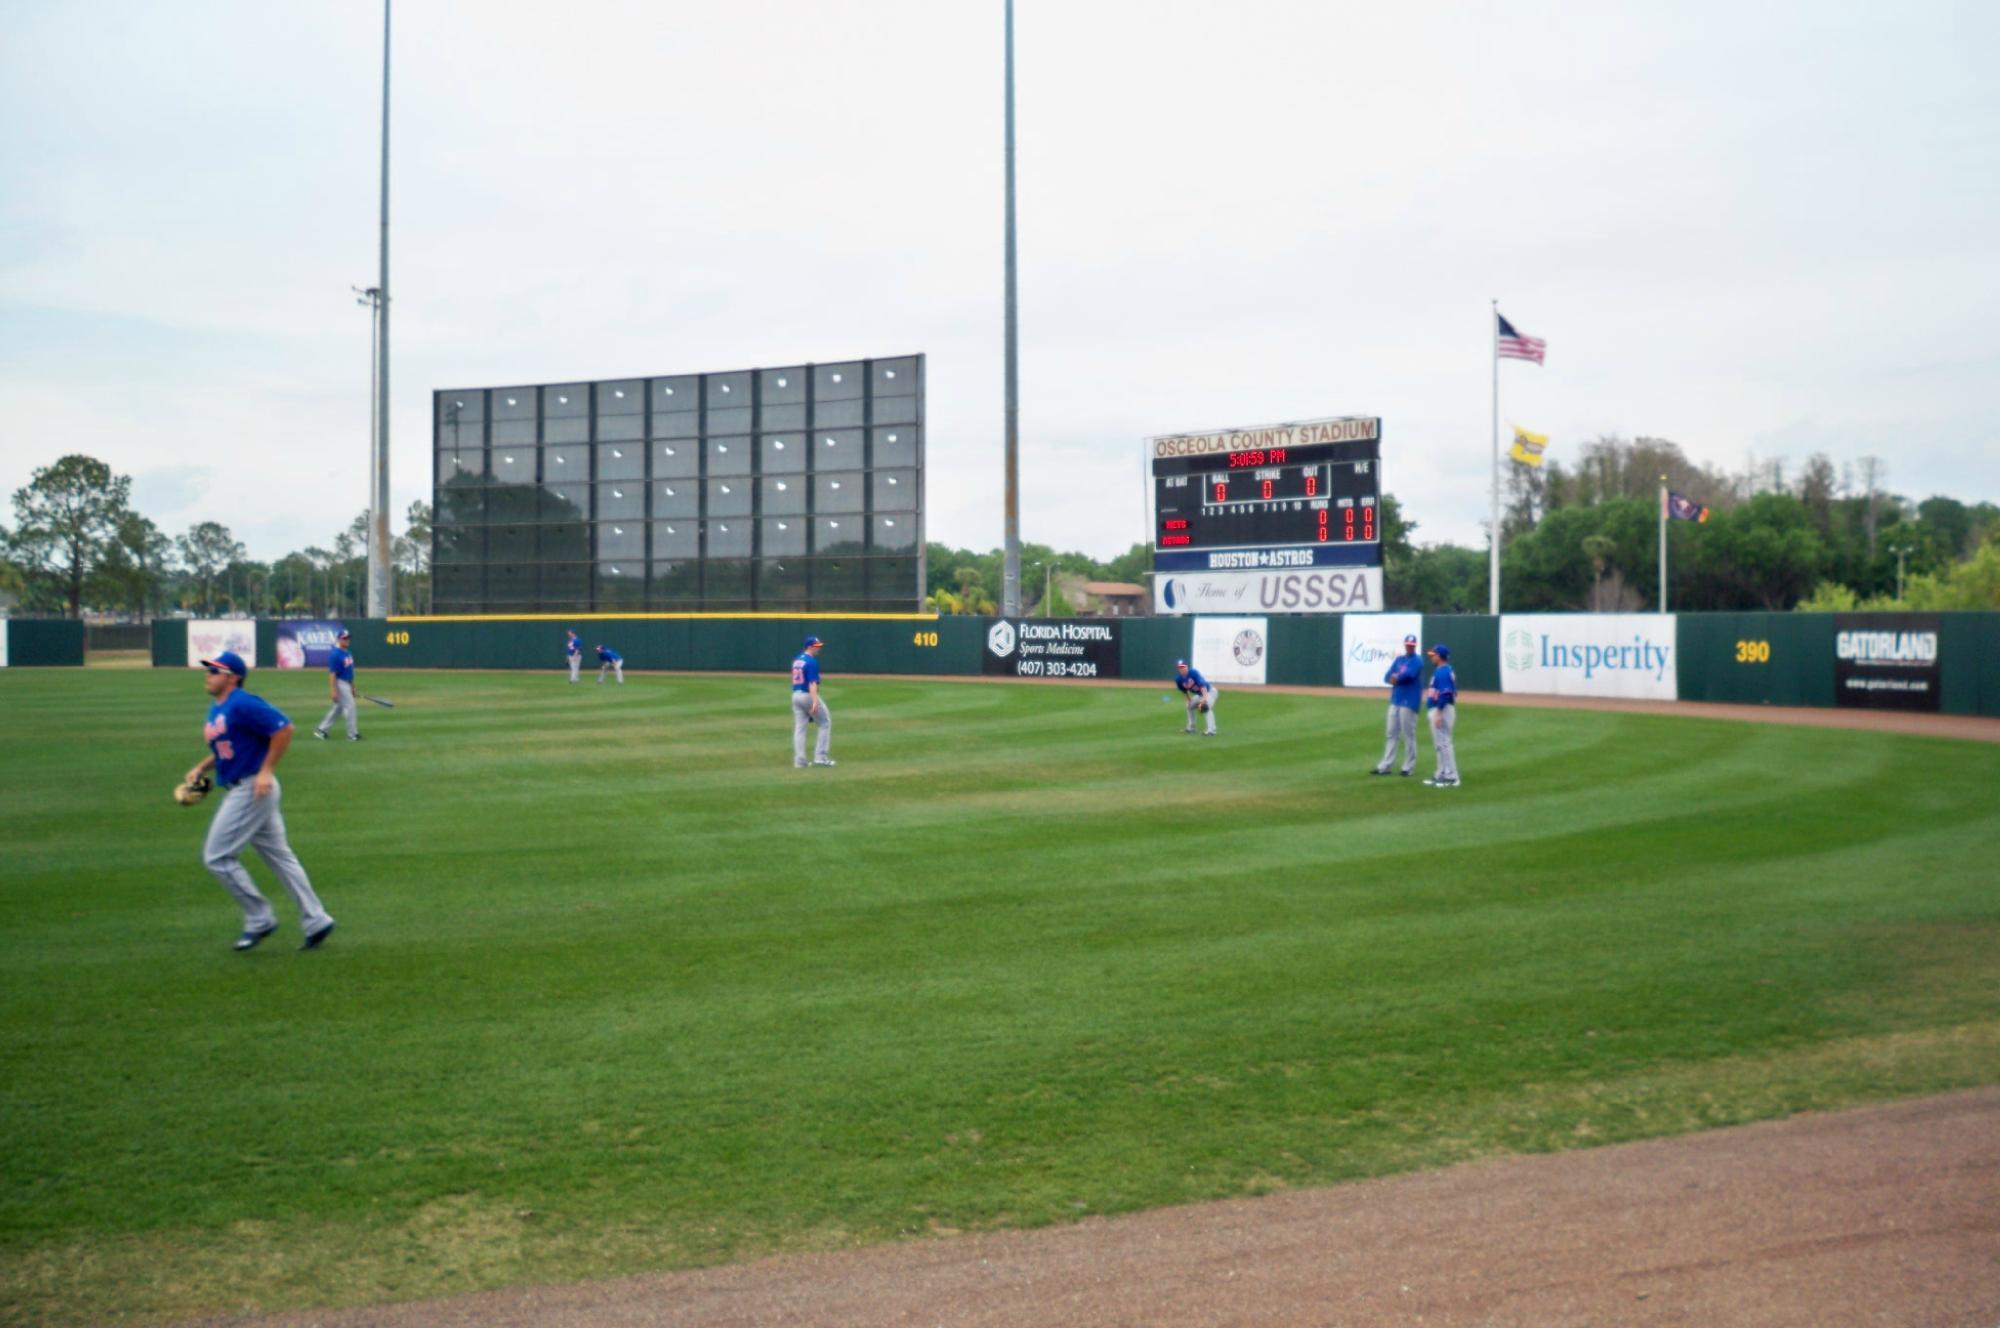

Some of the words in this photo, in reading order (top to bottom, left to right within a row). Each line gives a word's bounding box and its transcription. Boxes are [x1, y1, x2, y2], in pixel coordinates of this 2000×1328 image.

[1156, 437, 1225, 456] OSCEOLA
[1230, 428, 1294, 450] COUNTY
[1300, 420, 1375, 443] STADIUM
[1270, 448, 1286, 464] PM
[1255, 468, 1281, 480] STRIKE
[1319, 509, 1327, 525] 0
[1346, 507, 1354, 523] 0
[1365, 506, 1373, 522] 0
[1319, 527, 1327, 543] 0
[1346, 525, 1354, 541] 0
[1365, 524, 1373, 540] 0
[1209, 552, 1258, 568] HOUSTON
[1270, 550, 1314, 567] ASTROS
[1260, 573, 1370, 609] USSSA
[386, 632, 410, 645] 410
[914, 632, 938, 646] 410
[1020, 623, 1061, 639] FLORIDA
[1062, 624, 1113, 640] HOSPITAL
[1019, 641, 1045, 657] Sports
[1046, 642, 1085, 655] Medicine
[1736, 641, 1770, 662] 390
[1837, 632, 1937, 660] GATORLAND
[1540, 634, 1669, 681] Insperity
[1017, 660, 1044, 676] (407)
[1047, 661, 1097, 676] 303-4204
